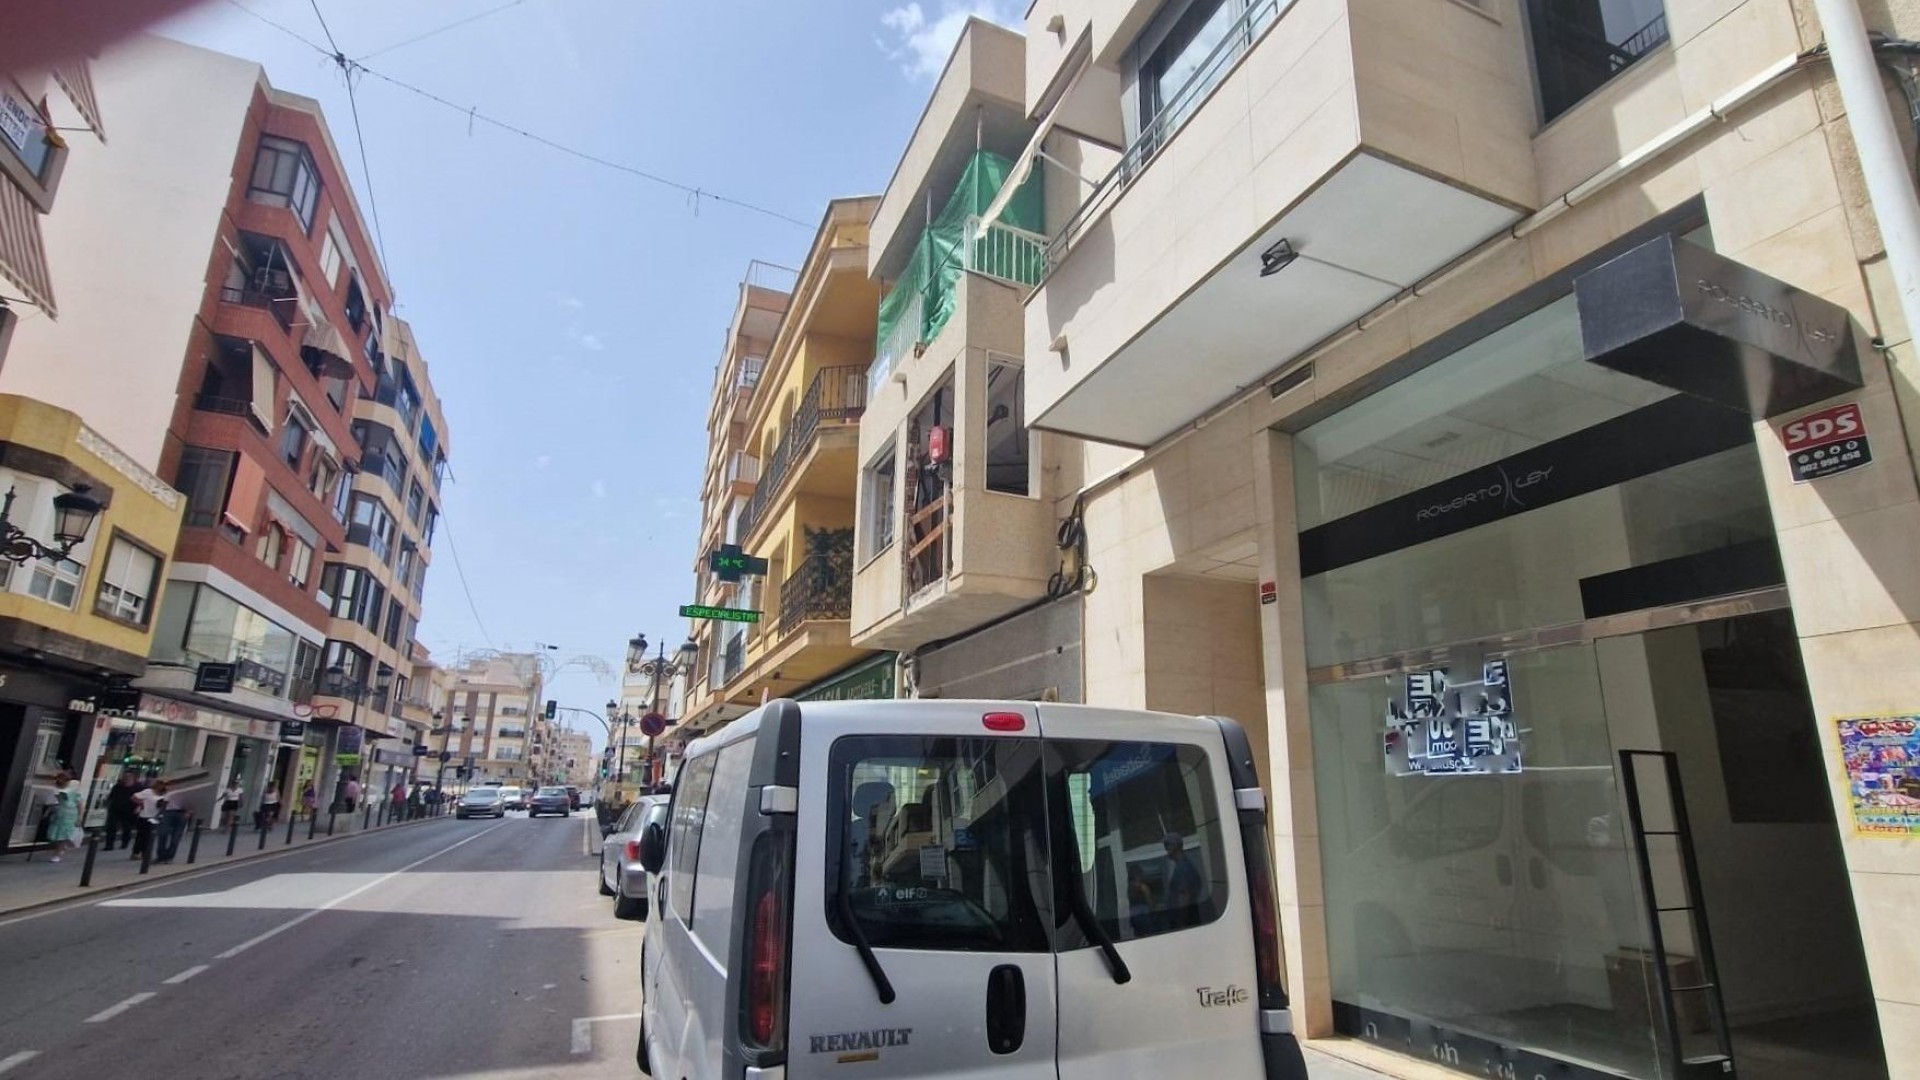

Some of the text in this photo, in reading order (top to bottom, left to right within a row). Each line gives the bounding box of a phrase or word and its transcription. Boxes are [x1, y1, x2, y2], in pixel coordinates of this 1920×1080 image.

[1697, 279, 1792, 328] ROBERTO
[1786, 411, 1859, 444] SDS
[1417, 465, 1553, 521] ROBERTO LEY
[809, 1027, 913, 1054] RENAULT
